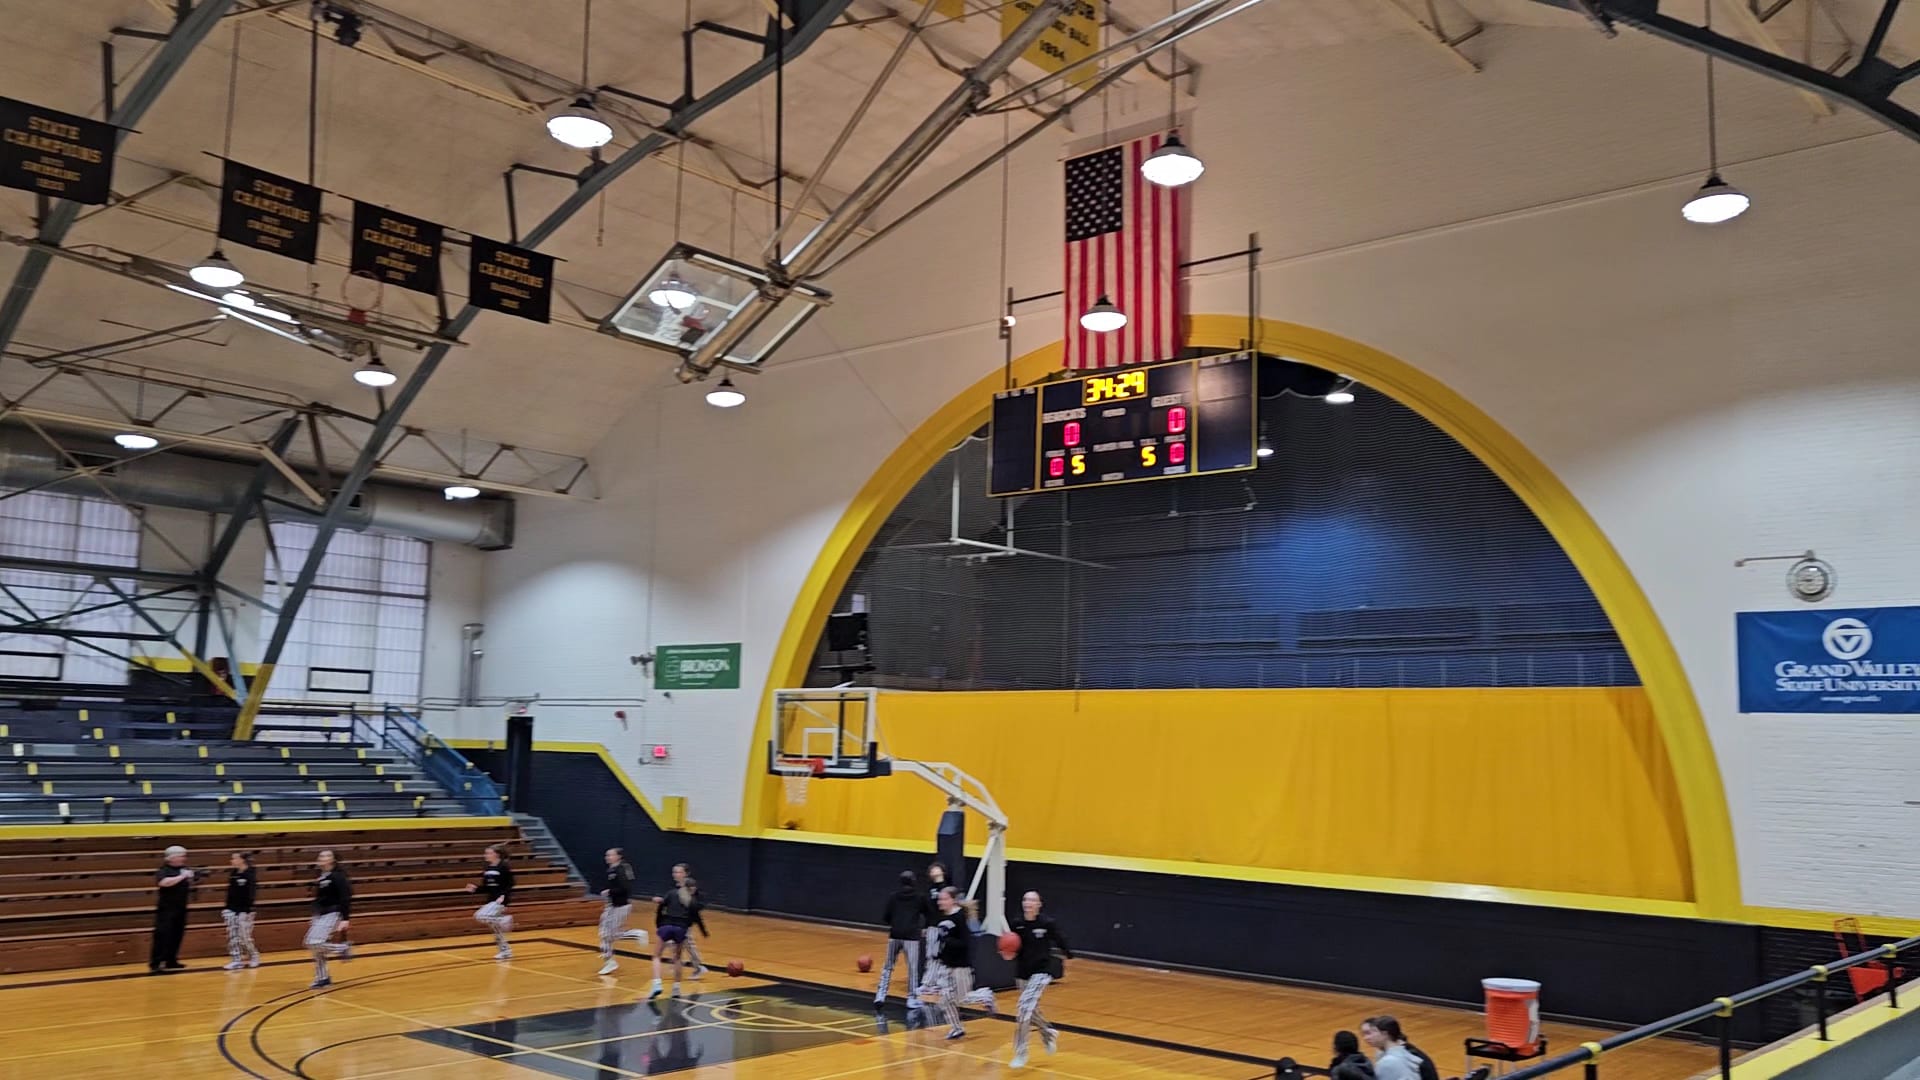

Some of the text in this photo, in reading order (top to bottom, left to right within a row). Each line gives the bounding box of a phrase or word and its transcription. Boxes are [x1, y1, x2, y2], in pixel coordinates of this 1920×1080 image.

[27, 115, 81, 140] STATE
[3, 128, 103, 164] CHAMPIONS
[253, 179, 296, 202] STATE
[232, 189, 311, 223] CHAMPIONS
[380, 217, 417, 237] STATE
[362, 229, 433, 257] CHAMPIONS
[495, 250, 530, 270] STATE
[478, 262, 545, 288] CHAMPIONS
[1086, 371, 1145, 402] 34:29
[1167, 406, 1187, 433] 0
[1063, 422, 1081, 446] 0
[1070, 454, 1086, 475] 5
[1141, 446, 1157, 467] 5
[1169, 442, 1186, 463] 0
[1049, 457, 1065, 476] 0
